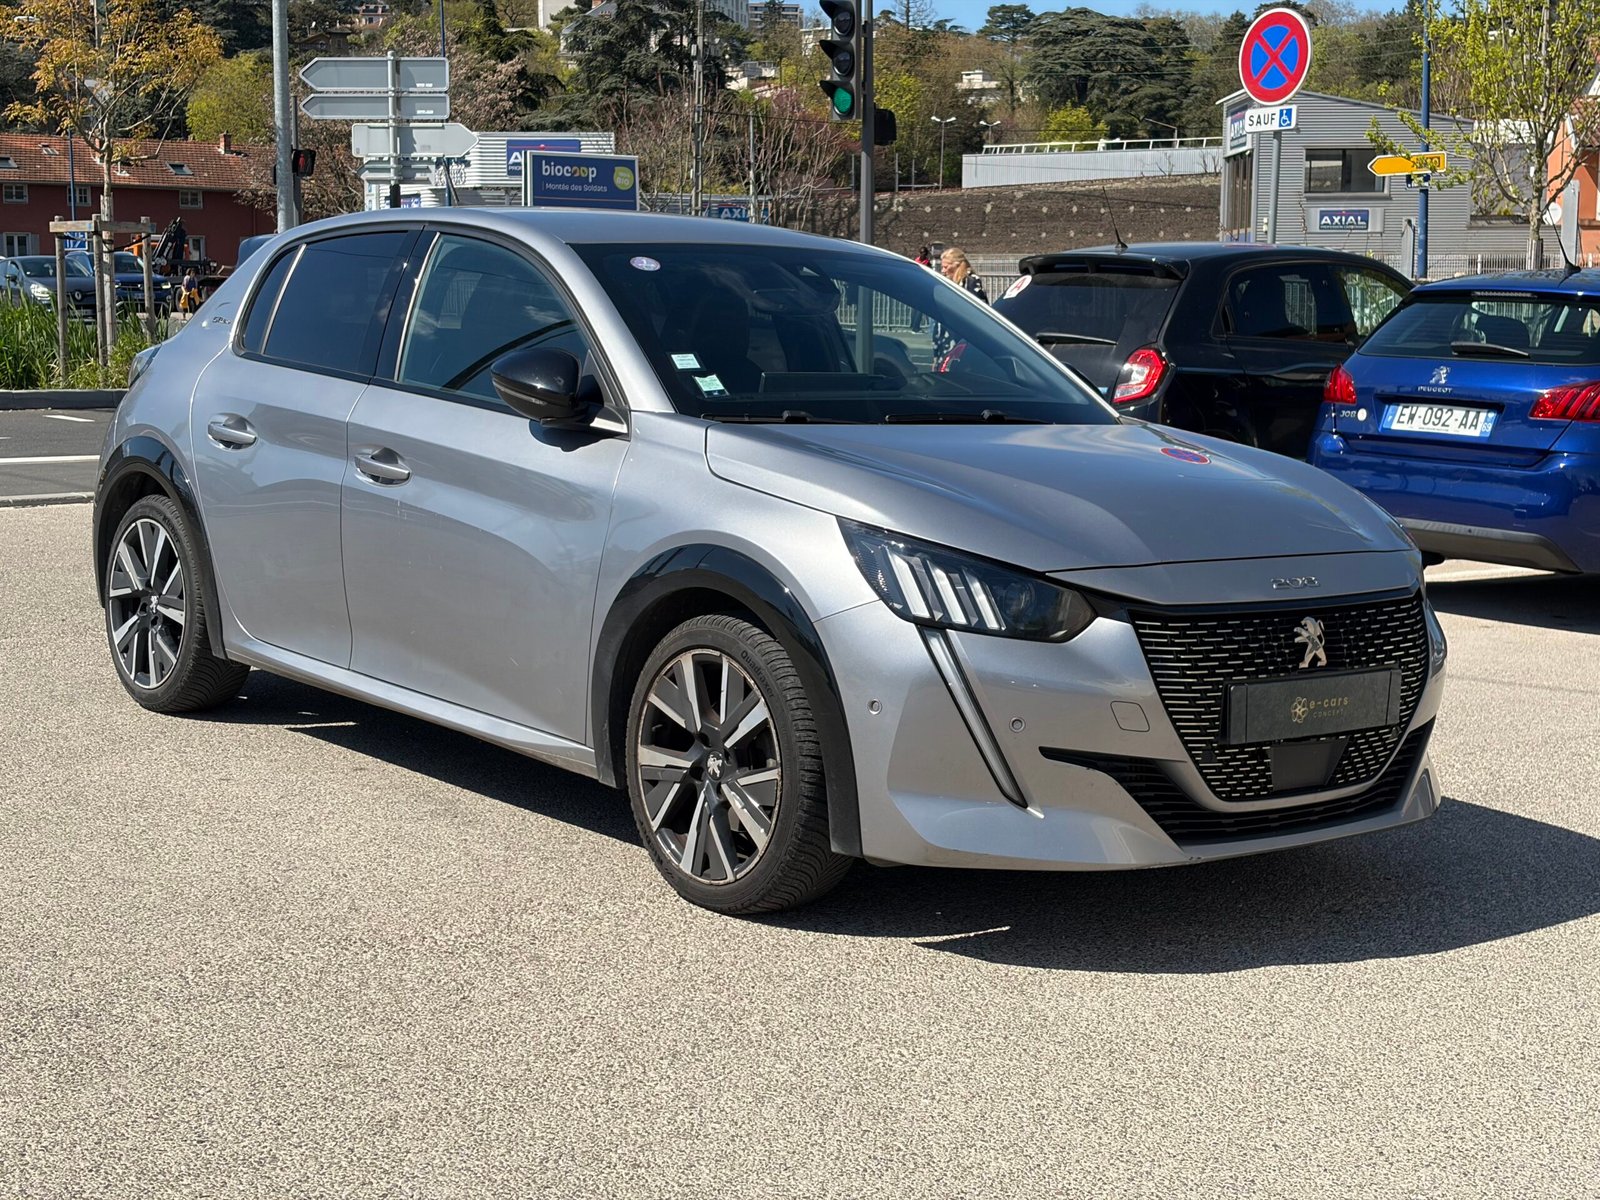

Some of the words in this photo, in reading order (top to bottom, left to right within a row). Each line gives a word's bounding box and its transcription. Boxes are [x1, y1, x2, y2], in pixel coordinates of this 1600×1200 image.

[1248, 112, 1276, 126] SAUF
[542, 160, 597, 183] biocoop
[545, 183, 570, 191] Montée
[583, 184, 608, 193] Soldats
[1320, 215, 1366, 225] AXIAL
[1396, 404, 1482, 430] EW-092-AA
[1310, 697, 1349, 709] e-cars
